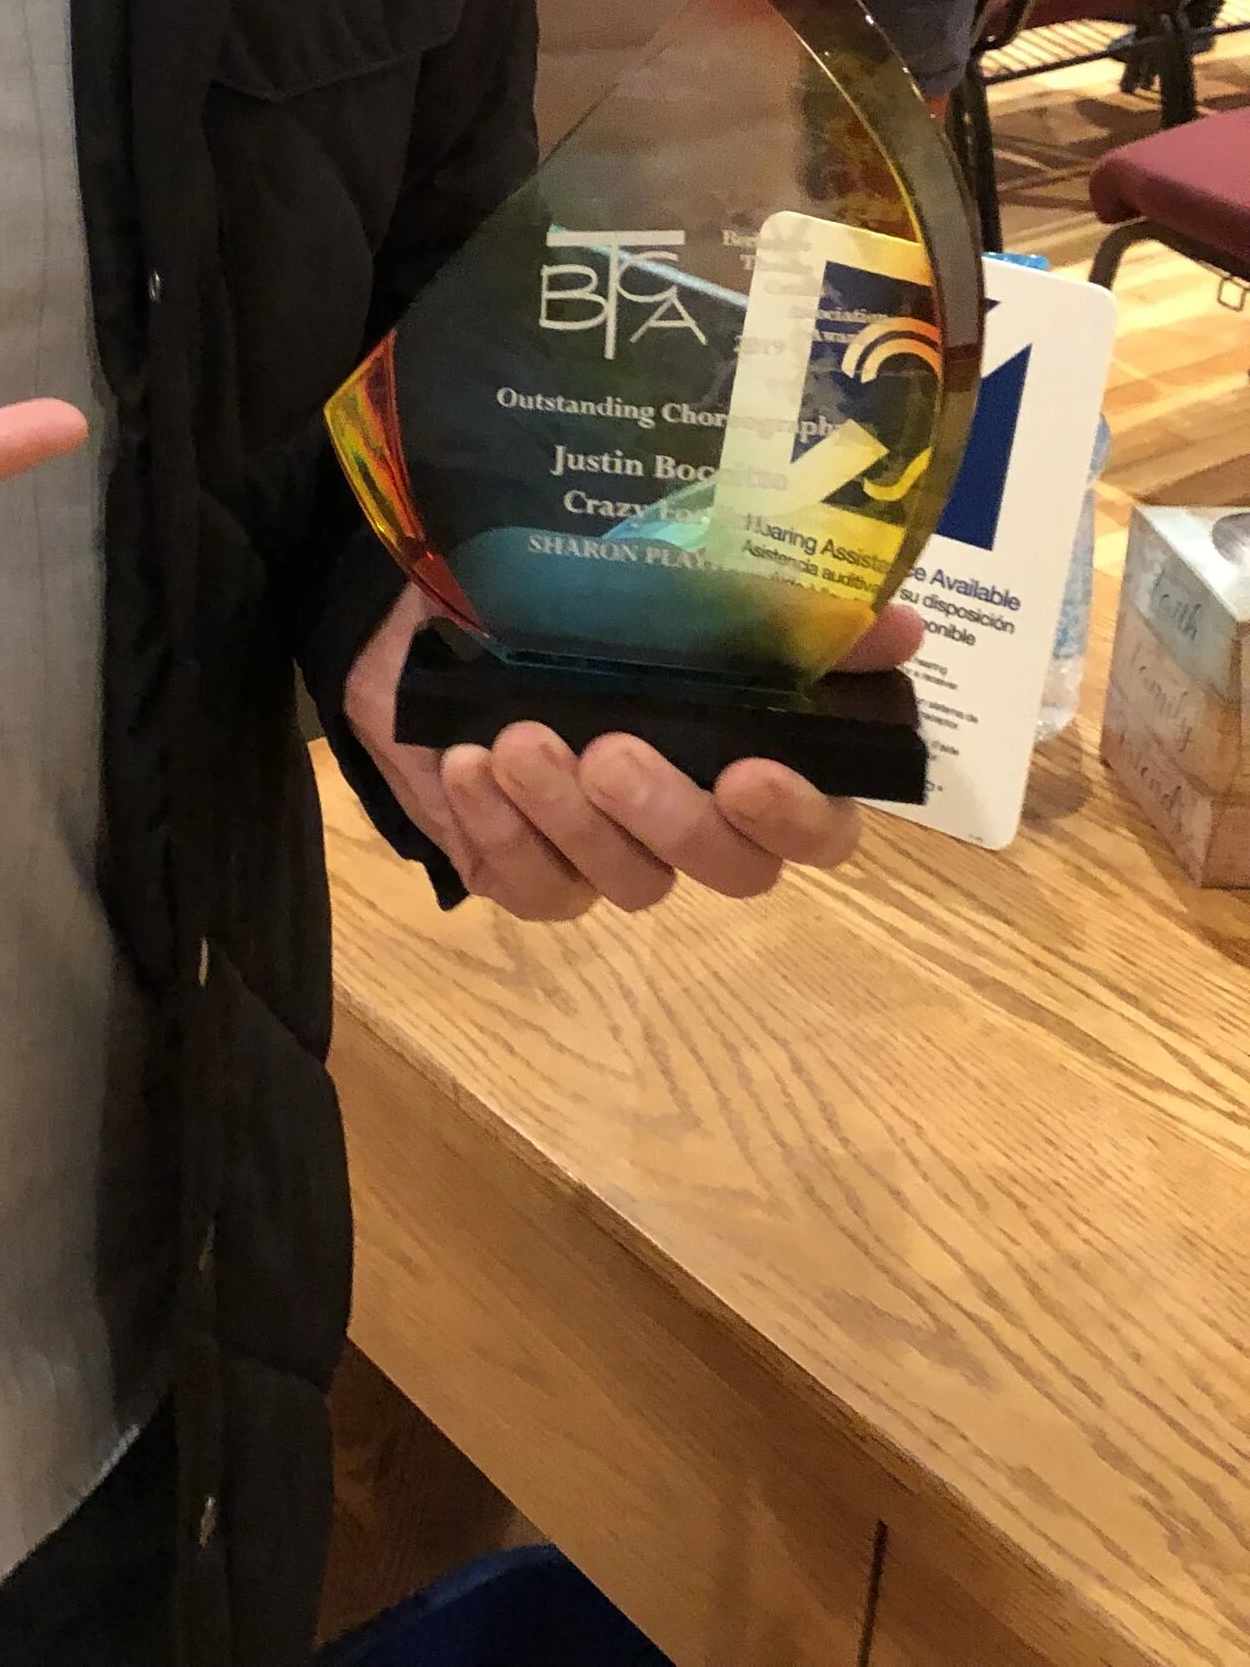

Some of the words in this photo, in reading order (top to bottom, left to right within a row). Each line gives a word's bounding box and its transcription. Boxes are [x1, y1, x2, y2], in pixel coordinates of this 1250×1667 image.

[495, 386, 654, 428] Outstanding
[550, 444, 644, 477] Justin
[563, 488, 649, 522] Crazy
[528, 533, 639, 563] SHARON
[930, 568, 1022, 614] Available
[899, 586, 920, 605] su
[921, 593, 1015, 635] disposición
